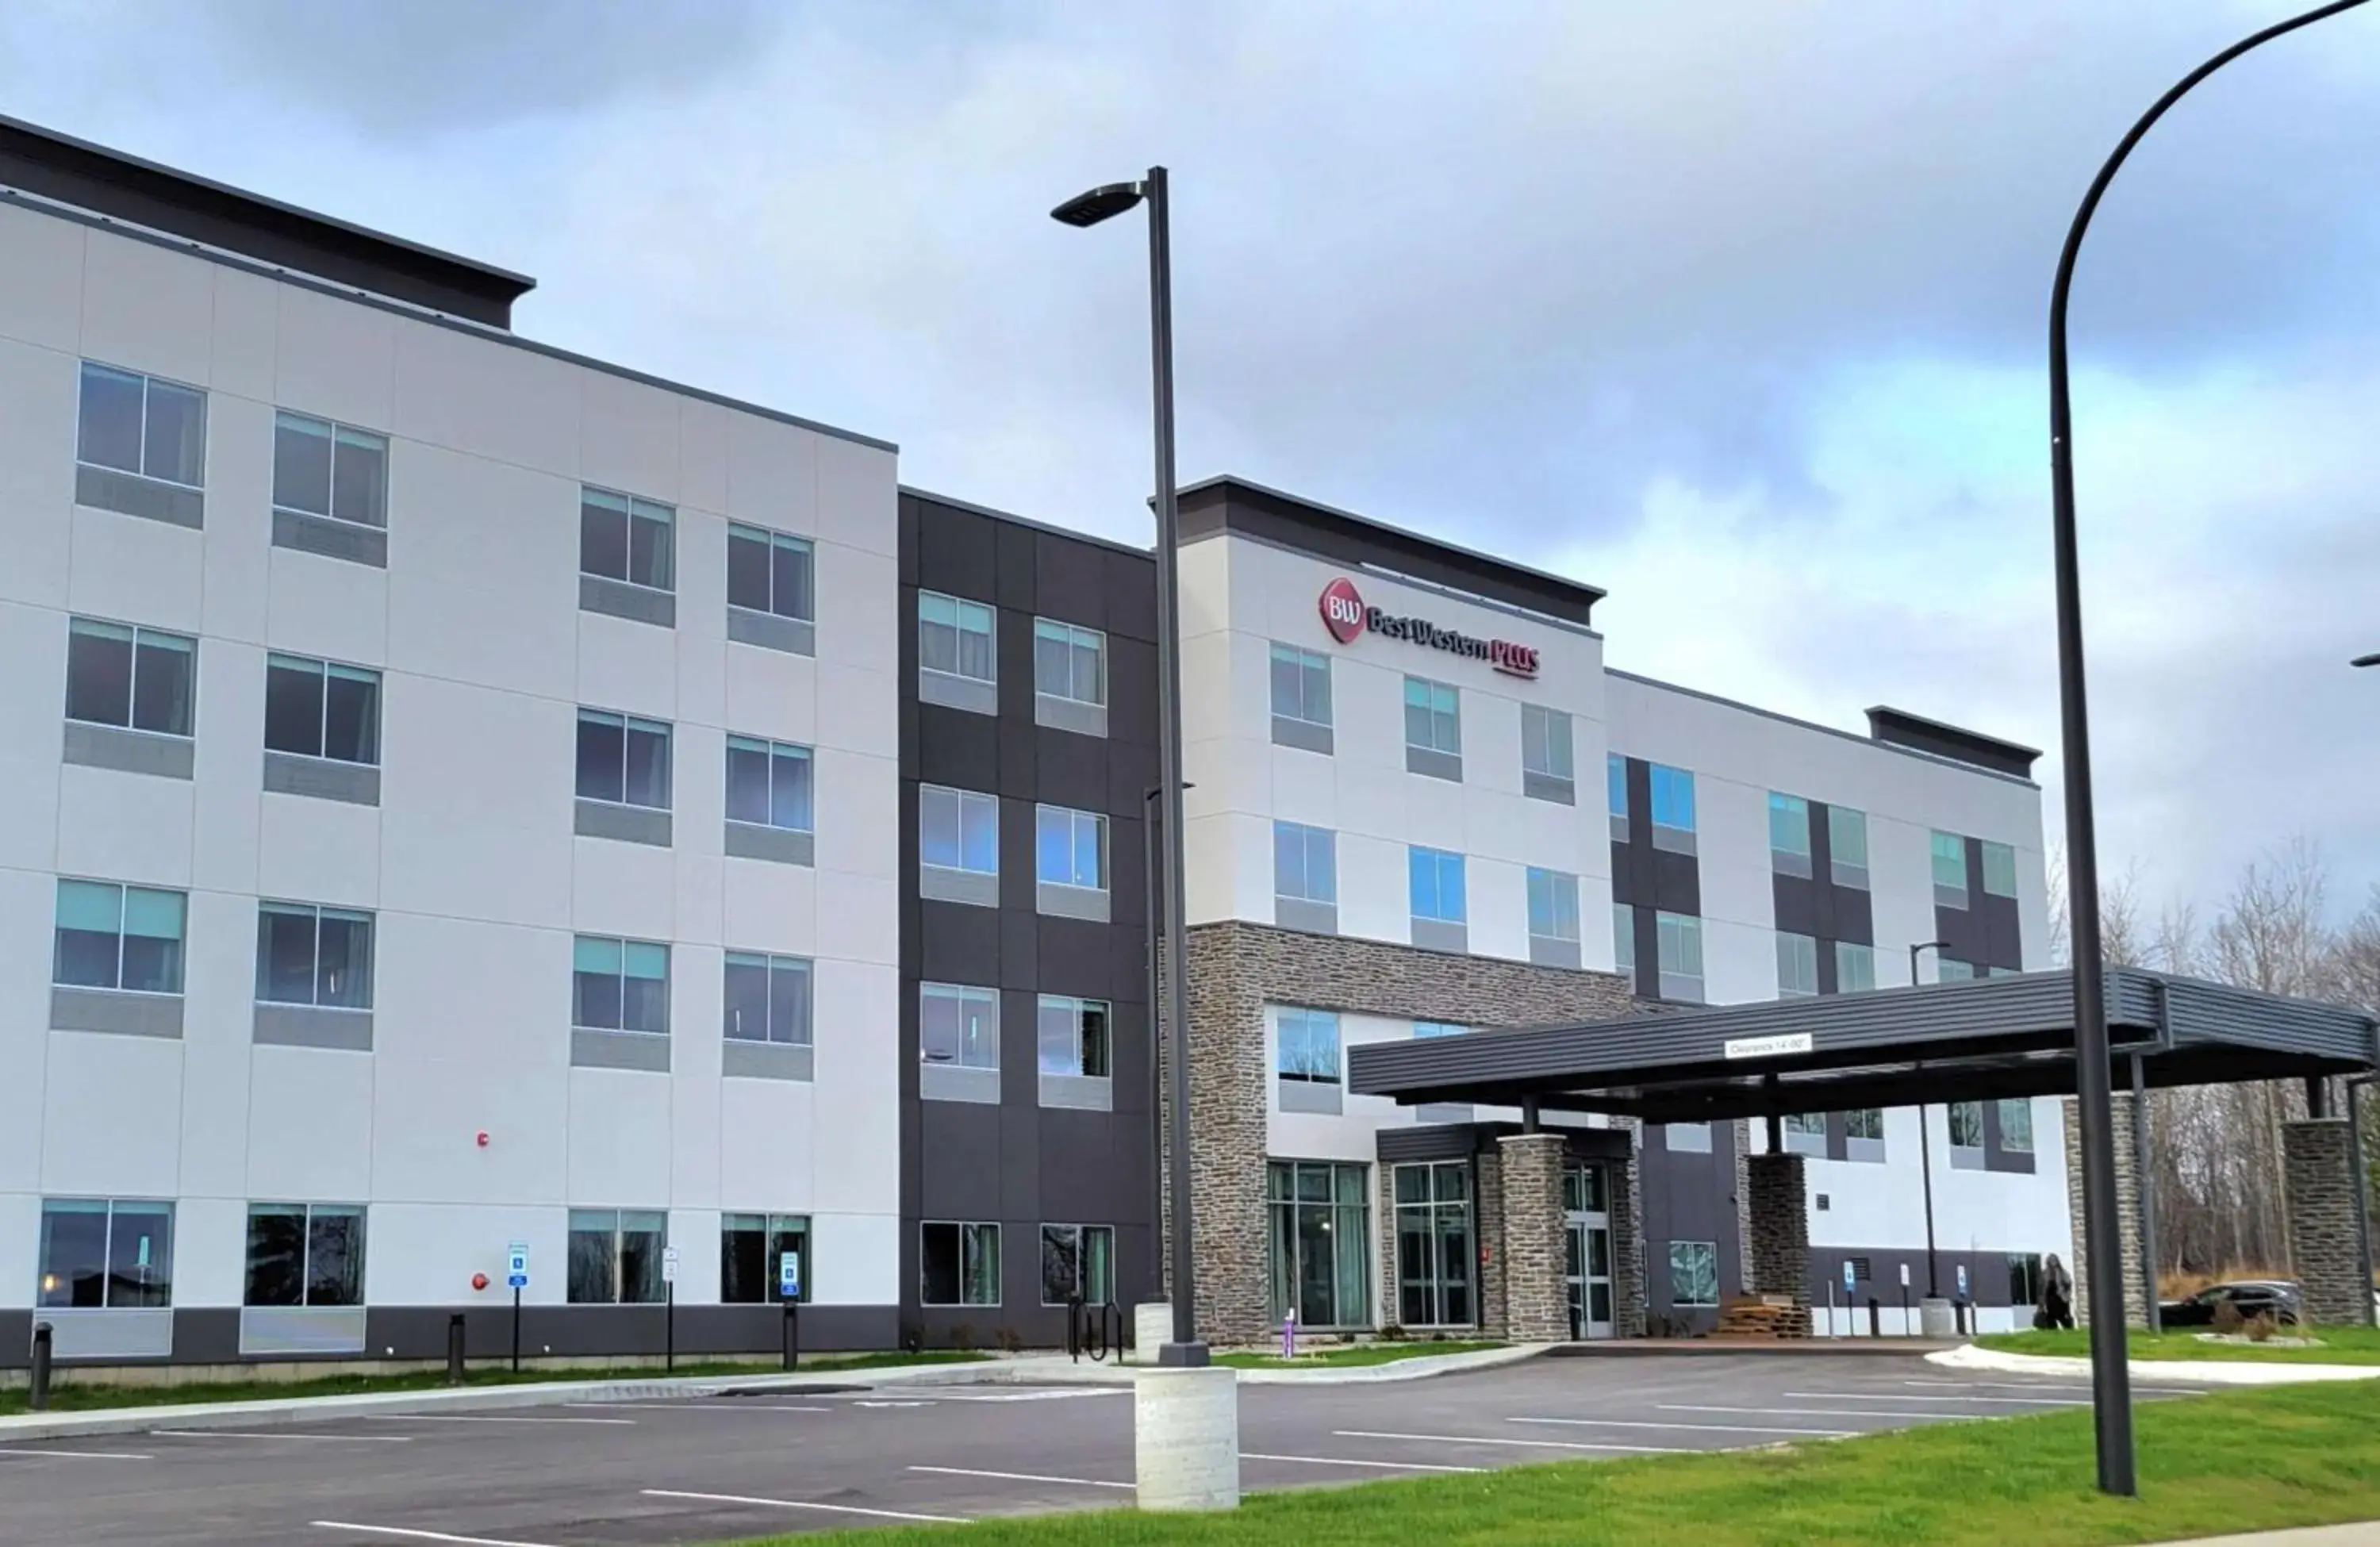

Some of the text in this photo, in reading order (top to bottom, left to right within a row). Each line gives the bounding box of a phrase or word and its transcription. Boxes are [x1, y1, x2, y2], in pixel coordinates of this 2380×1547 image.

[1329, 596, 1361, 625] BW
[1366, 606, 1540, 673] Best Western PLUS
